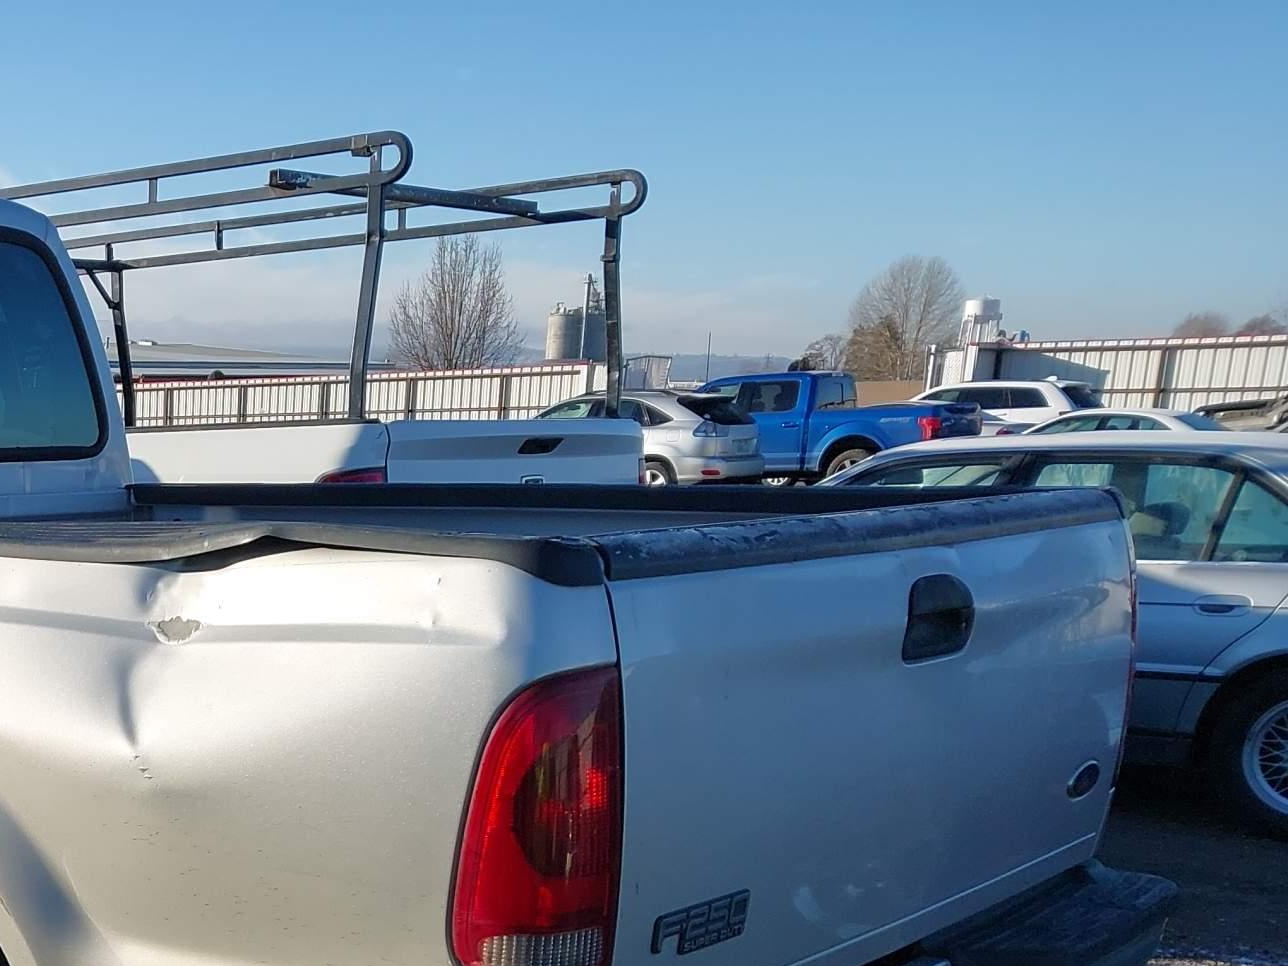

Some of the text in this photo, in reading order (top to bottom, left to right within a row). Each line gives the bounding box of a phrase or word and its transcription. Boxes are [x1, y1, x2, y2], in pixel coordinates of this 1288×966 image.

[651, 889, 750, 954] F250
[683, 924, 745, 952] SUPER DUTY
